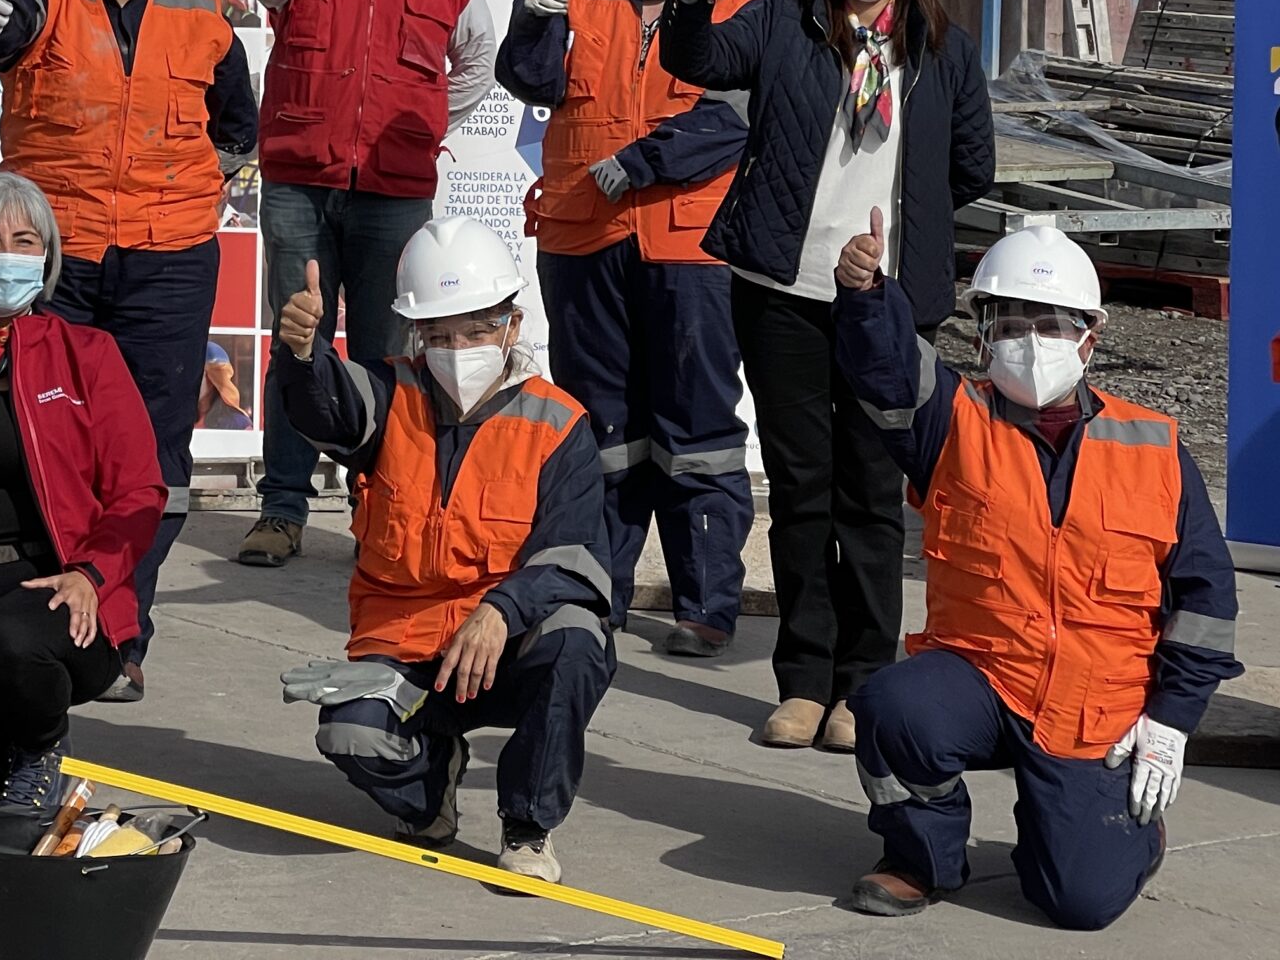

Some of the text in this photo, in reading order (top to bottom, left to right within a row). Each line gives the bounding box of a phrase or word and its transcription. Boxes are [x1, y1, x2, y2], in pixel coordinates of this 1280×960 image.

[489, 103, 509, 113] LOS
[467, 115, 515, 125] ESTOS DE
[461, 126, 507, 138] TRABAJO
[447, 171, 528, 181] CONSIDERA LA
[450, 183, 524, 193] SEGURIDAD Y
[448, 194, 484, 204] SALUD
[487, 195, 501, 205] DE
